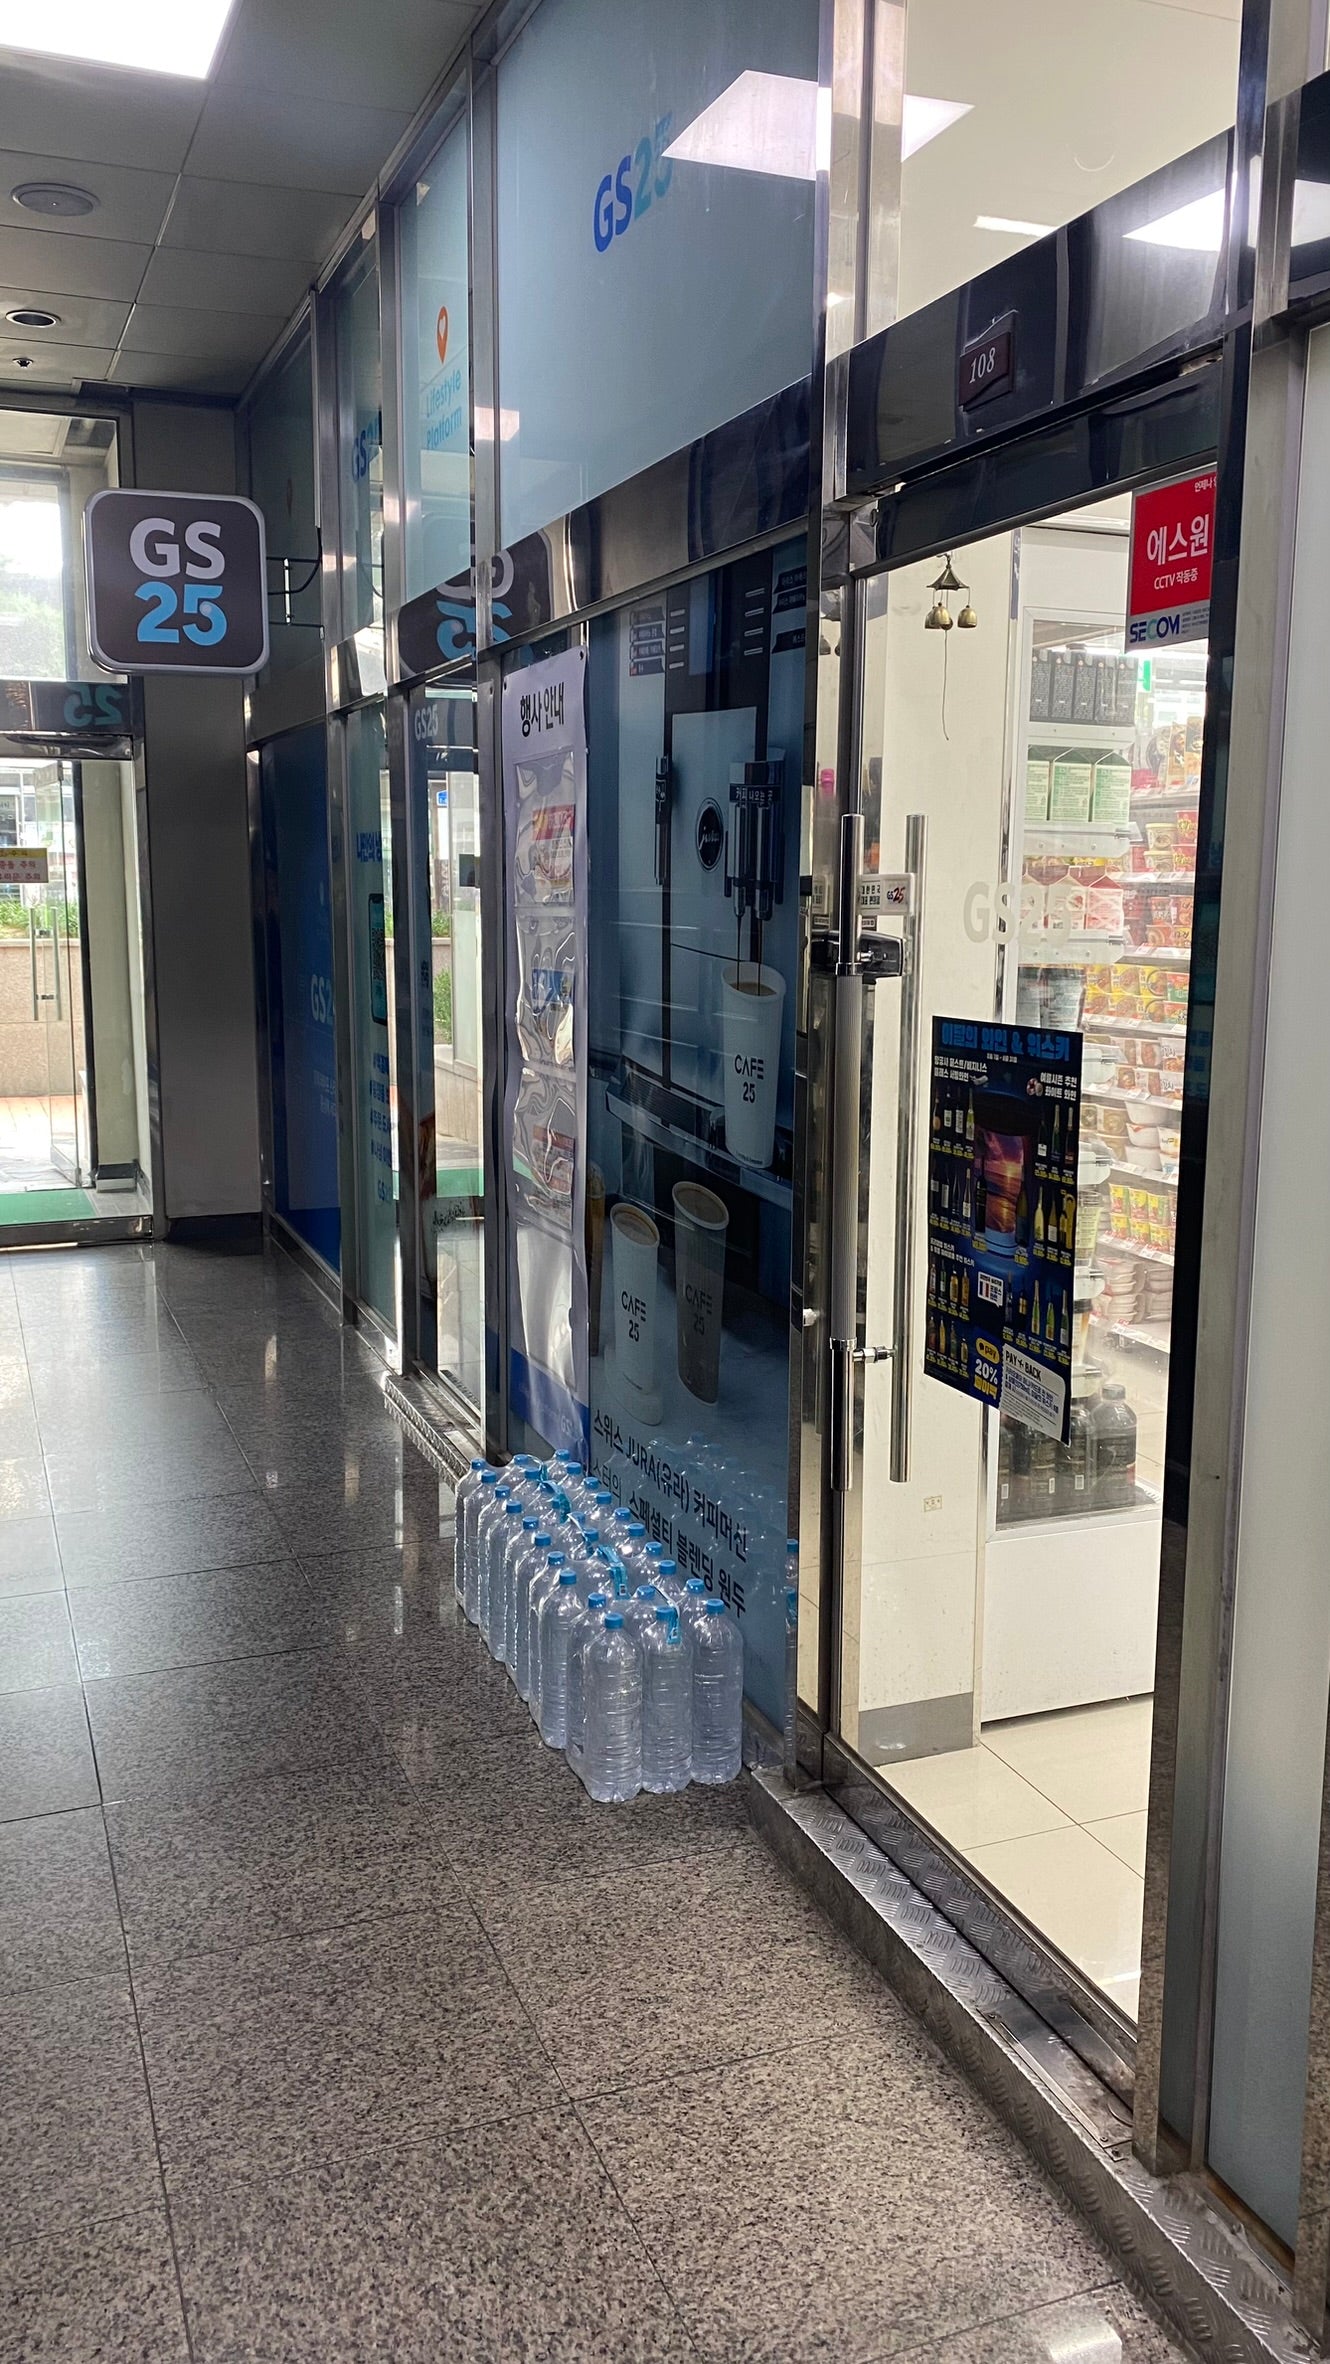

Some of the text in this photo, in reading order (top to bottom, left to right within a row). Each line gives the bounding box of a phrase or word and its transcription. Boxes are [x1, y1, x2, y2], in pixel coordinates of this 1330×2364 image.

[968, 347, 996, 384] 108
[426, 369, 462, 418] Lifestyle
[426, 407, 463, 450] Platform
[128, 517, 226, 580] GS
[1146, 513, 1210, 566] 에스원
[1153, 567, 1199, 591] CCTV 작동중
[134, 580, 228, 648] 25
[1129, 614, 1180, 643] SECOM
[414, 704, 439, 741] GS25
[735, 786, 748, 801] 커피
[748, 788, 765, 802] 나오는
[886, 886, 906, 904] GS25
[963, 880, 1073, 947] GS25
[941, 1022, 1070, 1062] 이달의 와인 & 위스키
[734, 1054, 764, 1081] CAFE
[742, 1081, 756, 1104] 25
[621, 1290, 647, 1323] CAFE
[684, 1283, 714, 1316] CAFE
[628, 1318, 640, 1343] 25
[692, 1311, 706, 1337] 25
[974, 1358, 999, 1385] 20%
[1005, 1350, 1042, 1383] PAY BACK
[593, 1408, 748, 1563] 스위스 JURA(유라) 커피머신
[629, 1490, 673, 1555] 스페셜티
[676, 1531, 714, 1593] 블렌딩
[718, 1568, 747, 1618] 원두
